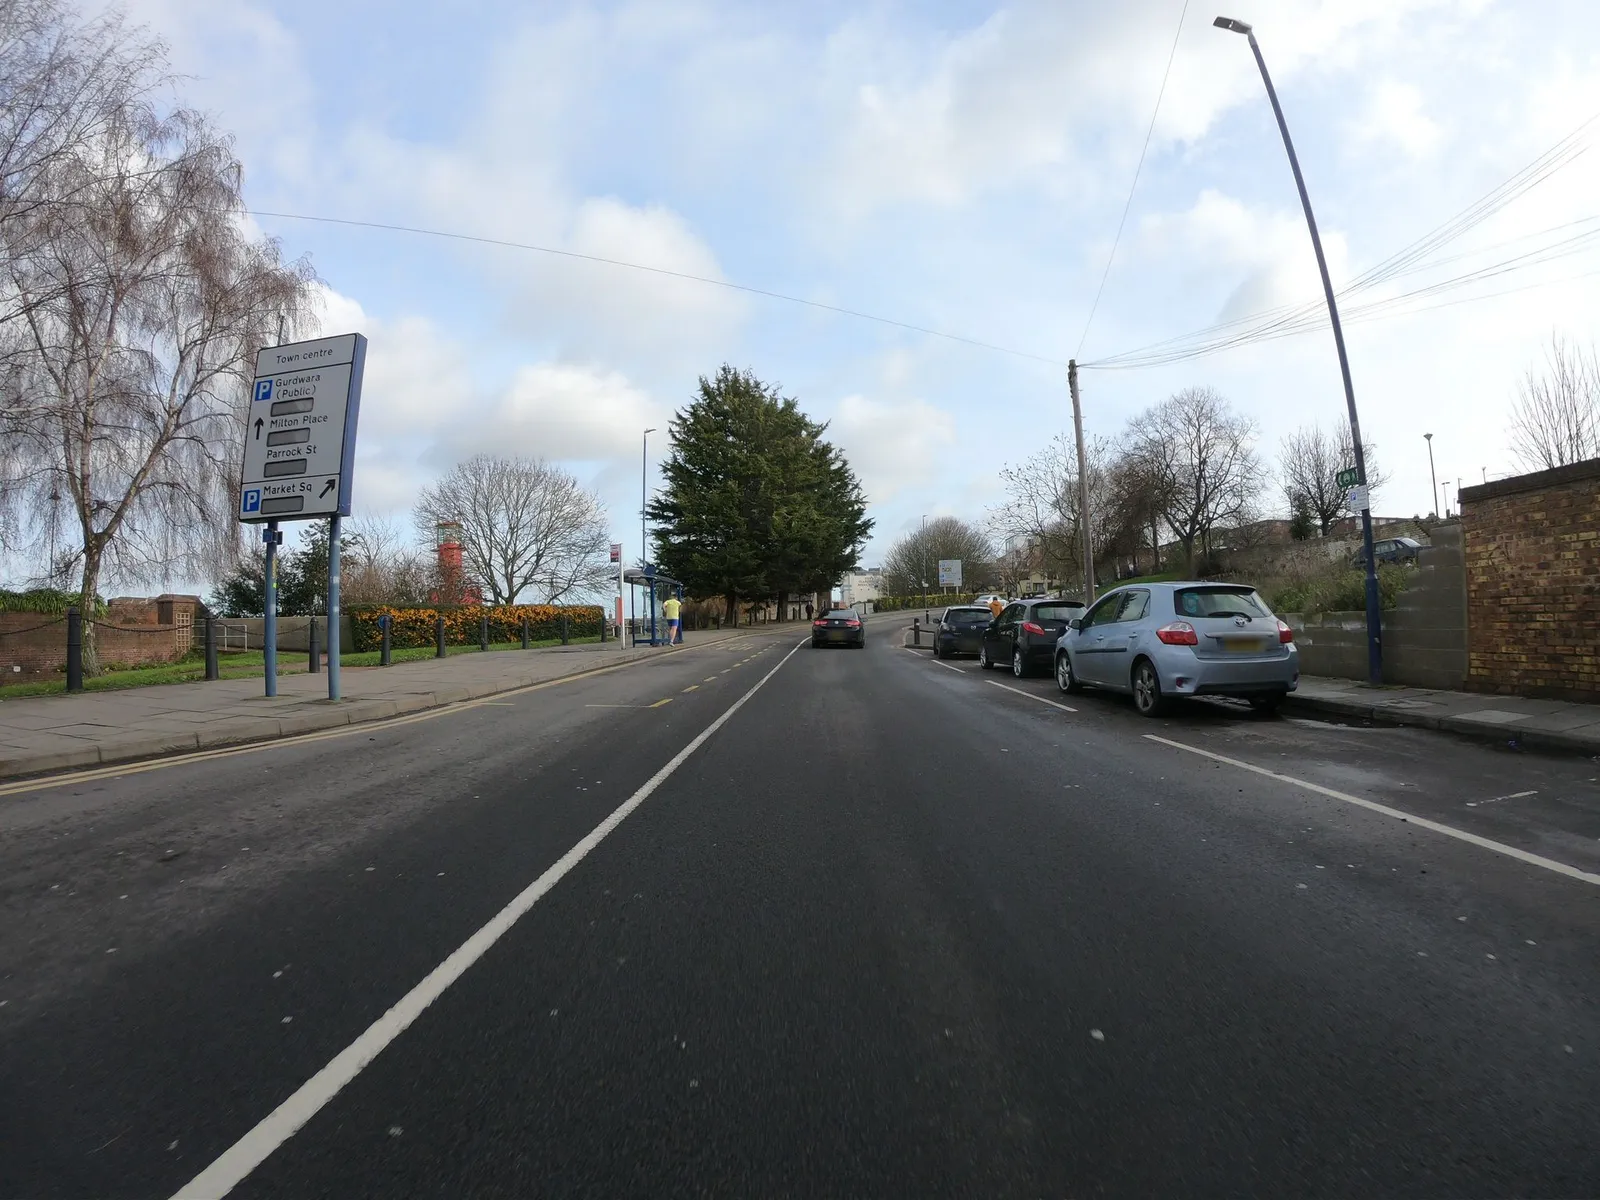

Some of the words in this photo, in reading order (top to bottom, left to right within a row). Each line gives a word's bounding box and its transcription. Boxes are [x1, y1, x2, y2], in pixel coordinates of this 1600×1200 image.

[276, 354, 300, 364] Town
[302, 348, 333, 360] centre
[275, 374, 321, 387] Gurdwara
[276, 385, 317, 400] (Public)
[270, 418, 299, 428] Milton
[302, 415, 329, 425] Place
[266, 446, 302, 459] Parrock
[305, 444, 317, 455] St
[263, 483, 296, 495] Market
[299, 482, 312, 492] Sq
